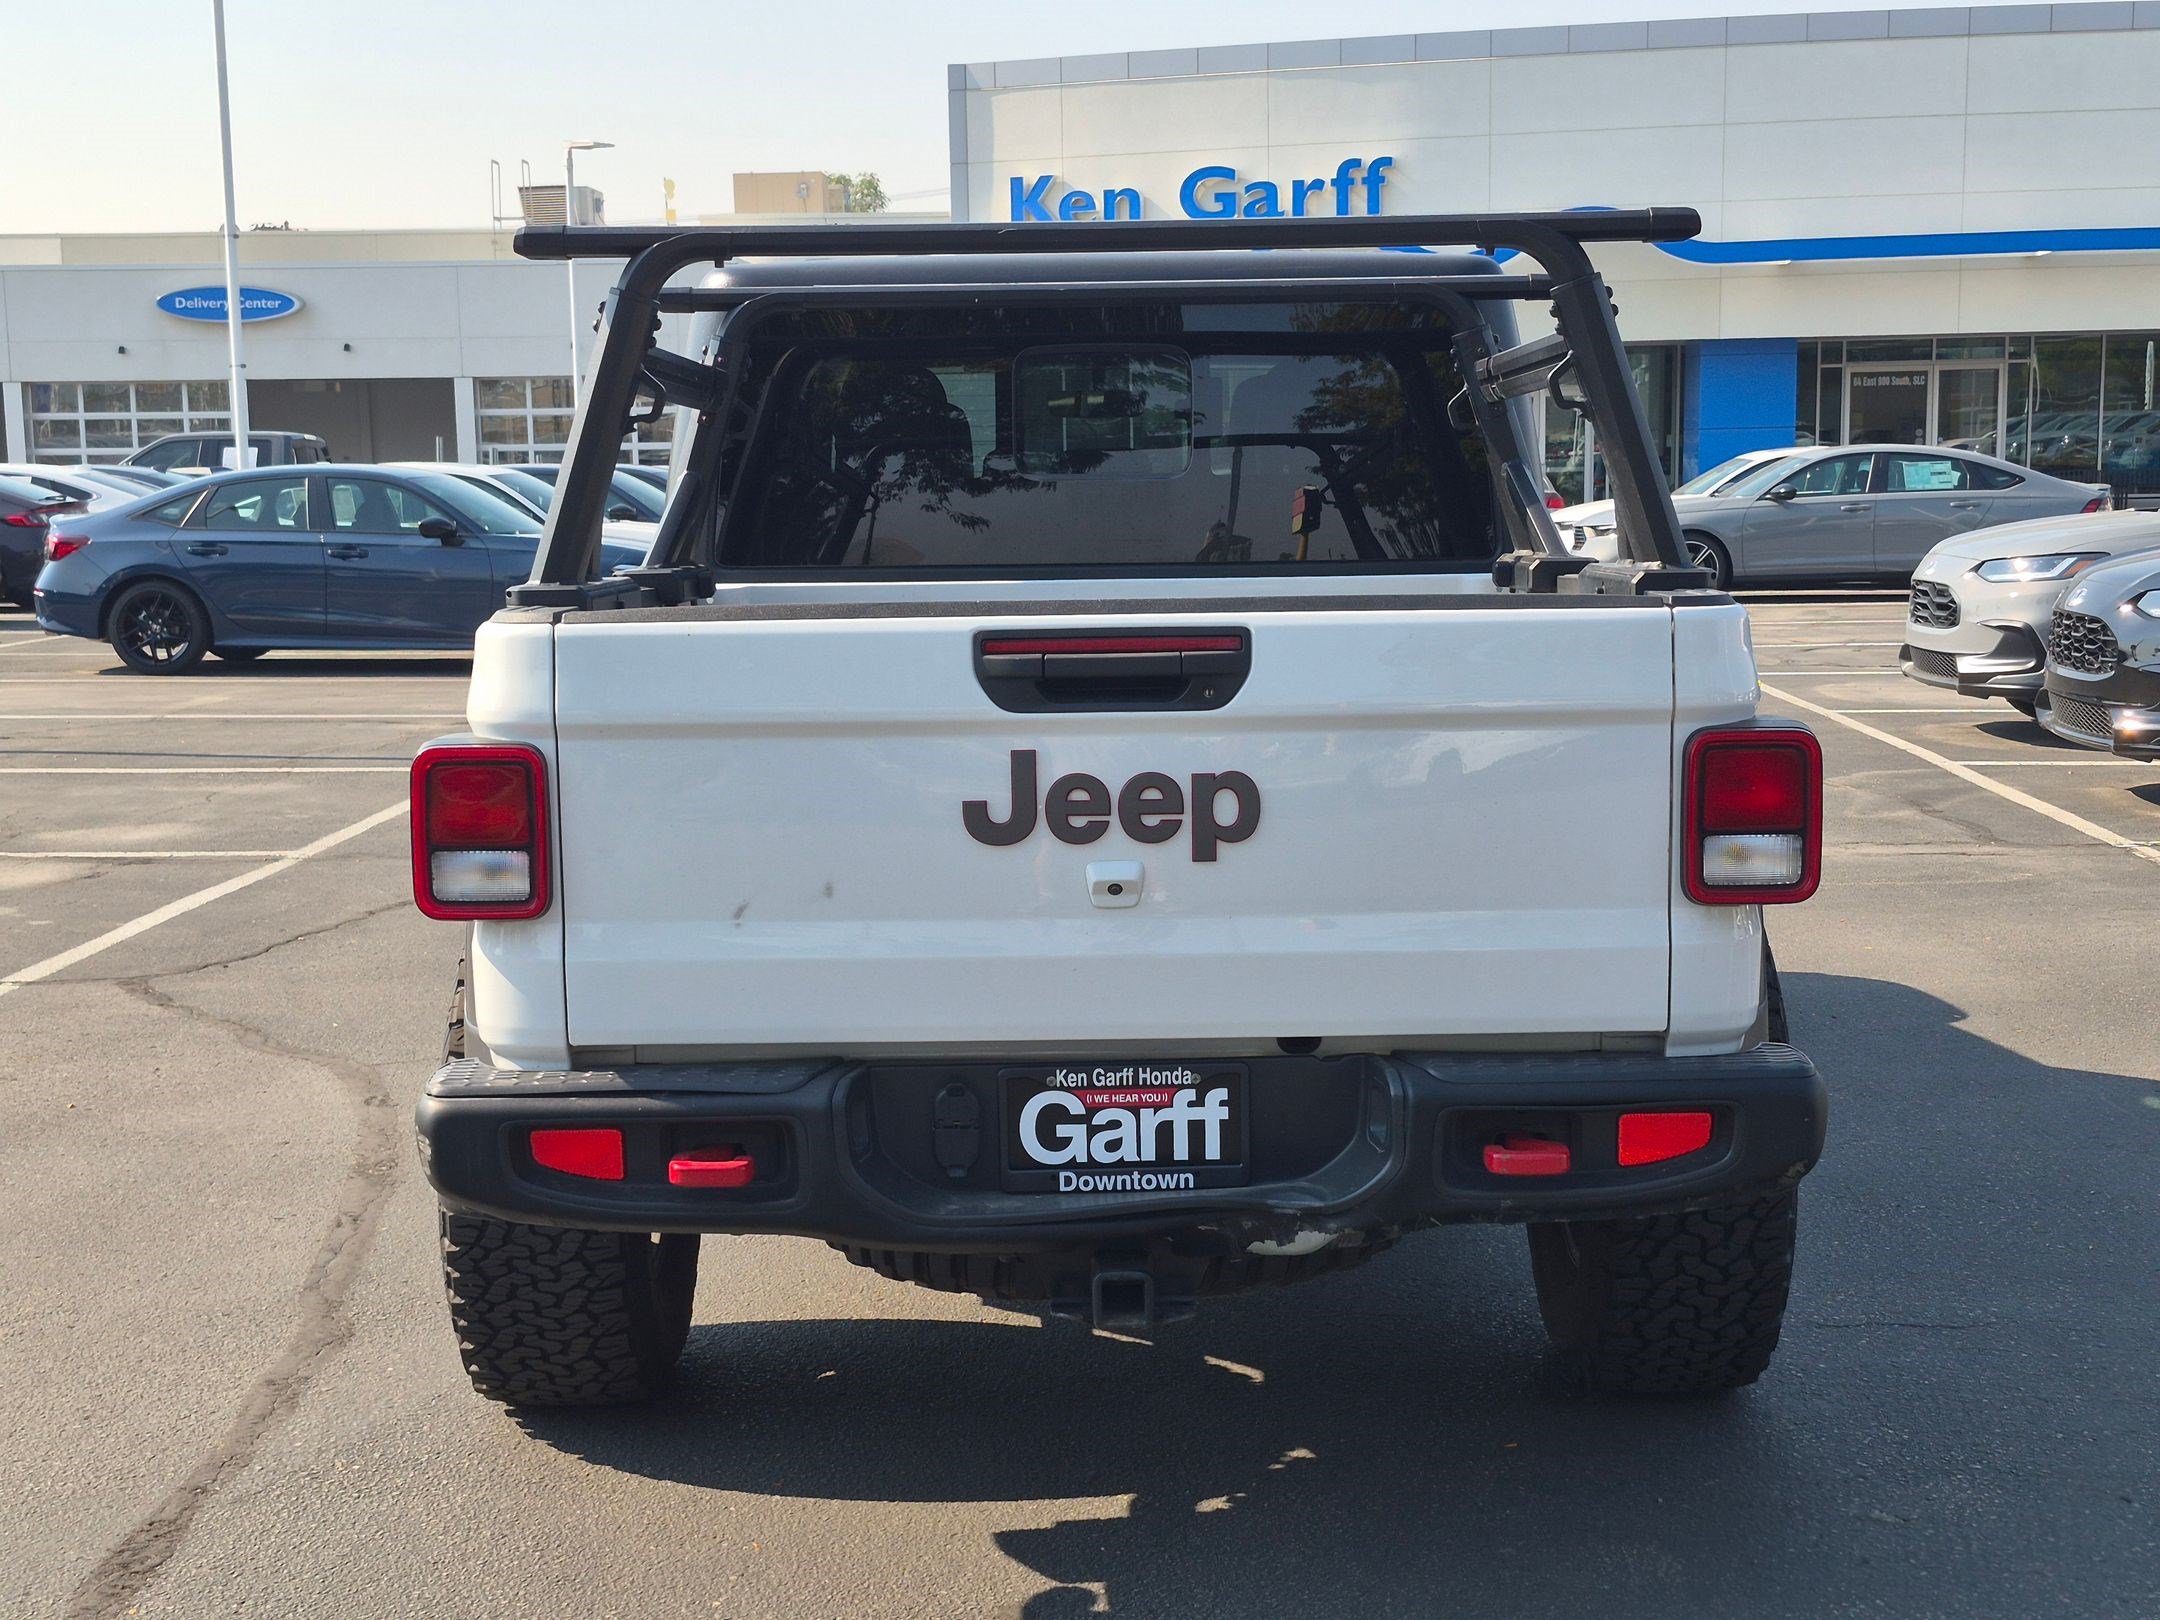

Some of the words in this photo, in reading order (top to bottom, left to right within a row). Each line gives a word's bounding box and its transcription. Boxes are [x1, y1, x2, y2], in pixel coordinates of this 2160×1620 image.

[1009, 174, 1143, 222] Ken
[1178, 156, 1394, 219] Garff
[175, 297, 229, 311] Delivery
[962, 749, 1261, 863] Jeep
[1055, 1069, 1088, 1088] Ken
[1092, 1067, 1134, 1087] Garff
[1138, 1066, 1192, 1086] Honda
[1094, 1093, 1111, 1103] WE
[1112, 1093, 1139, 1103] HEAR
[1140, 1093, 1162, 1102] YOU
[1019, 1087, 1229, 1165] Garff
[1059, 1170, 1194, 1192] Downtown
